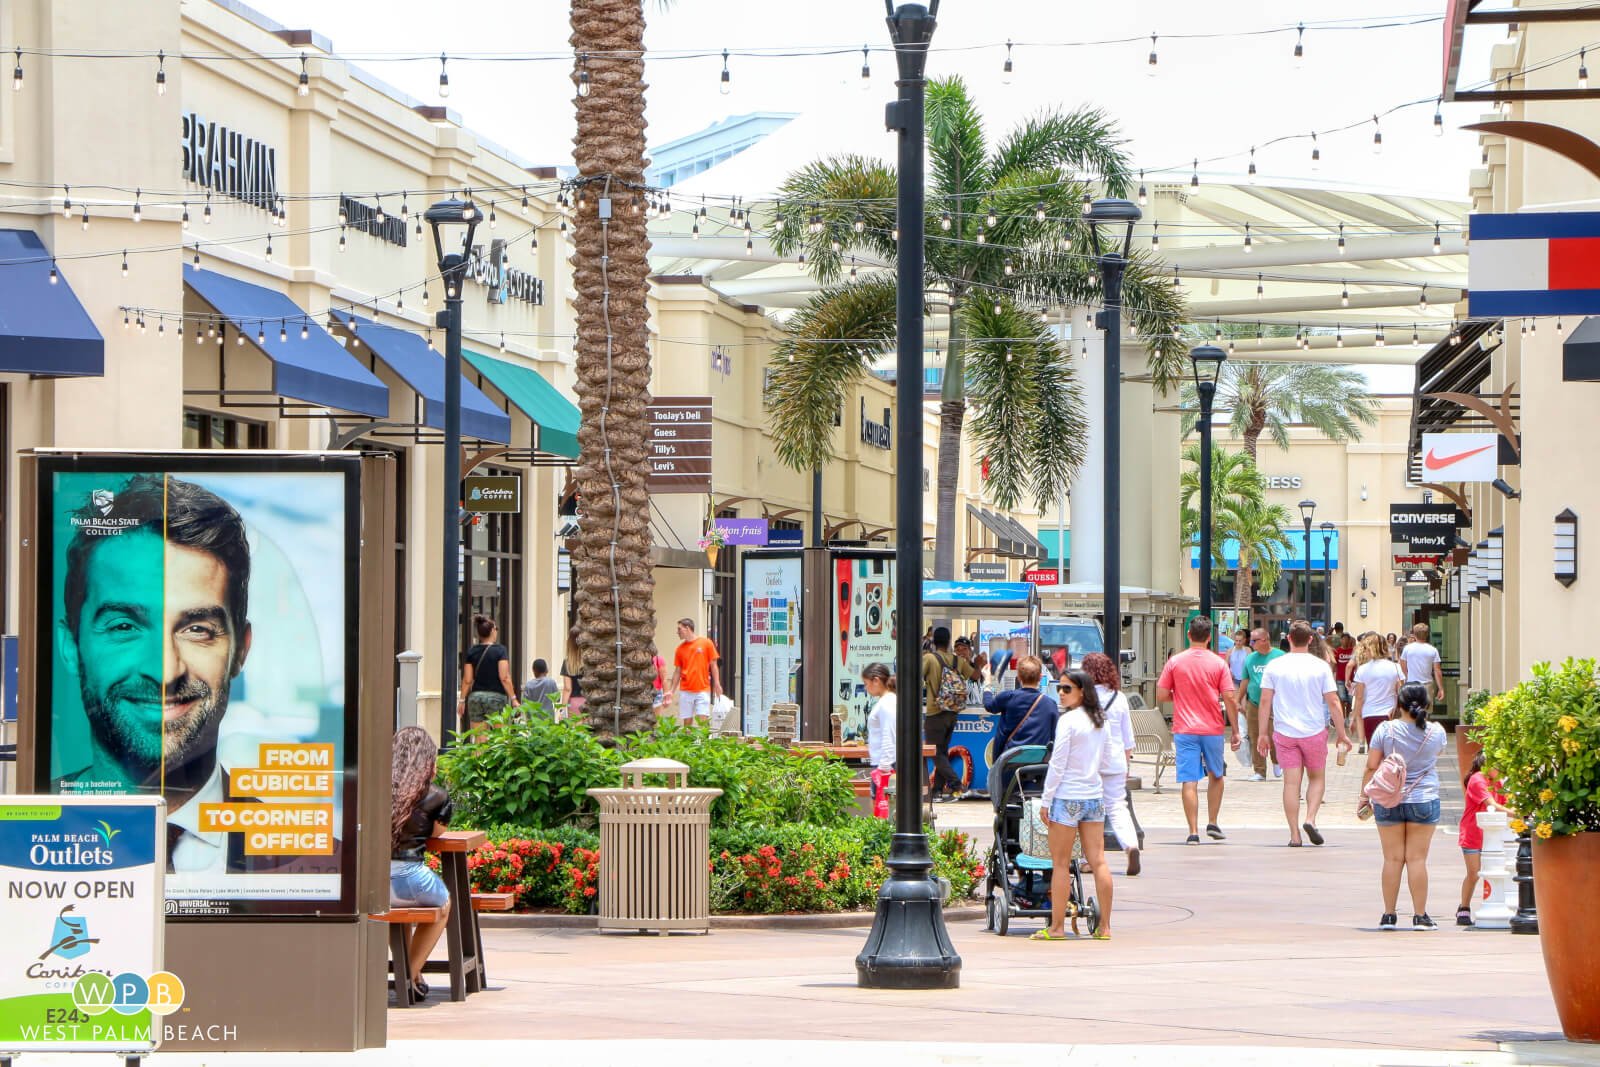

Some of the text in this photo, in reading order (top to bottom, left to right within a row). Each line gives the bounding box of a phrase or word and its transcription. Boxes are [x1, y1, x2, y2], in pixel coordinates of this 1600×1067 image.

[182, 111, 277, 210] BRAHMIN
[654, 411, 701, 421] TooJay's Deli
[654, 429, 677, 437] Guess
[654, 445, 676, 455] Tilly's
[654, 462, 675, 471] Levi's
[1264, 476, 1301, 489] RESS
[70, 517, 141, 526] PALM BEACH STATE
[1391, 513, 1456, 524] CONVERSE
[85, 528, 123, 536] COLLEGE
[740, 525, 763, 538] frais
[1411, 536, 1437, 546] Hurley
[953, 720, 991, 731] nne's
[265, 750, 329, 766] FROM
[237, 774, 329, 791] CUBICLE
[206, 809, 329, 826] TO CORNER
[31, 834, 98, 843] PALM BEACH
[250, 832, 328, 849] OFFICE
[30, 843, 113, 865] Outlets
[8, 881, 135, 898] NOW OPEN
